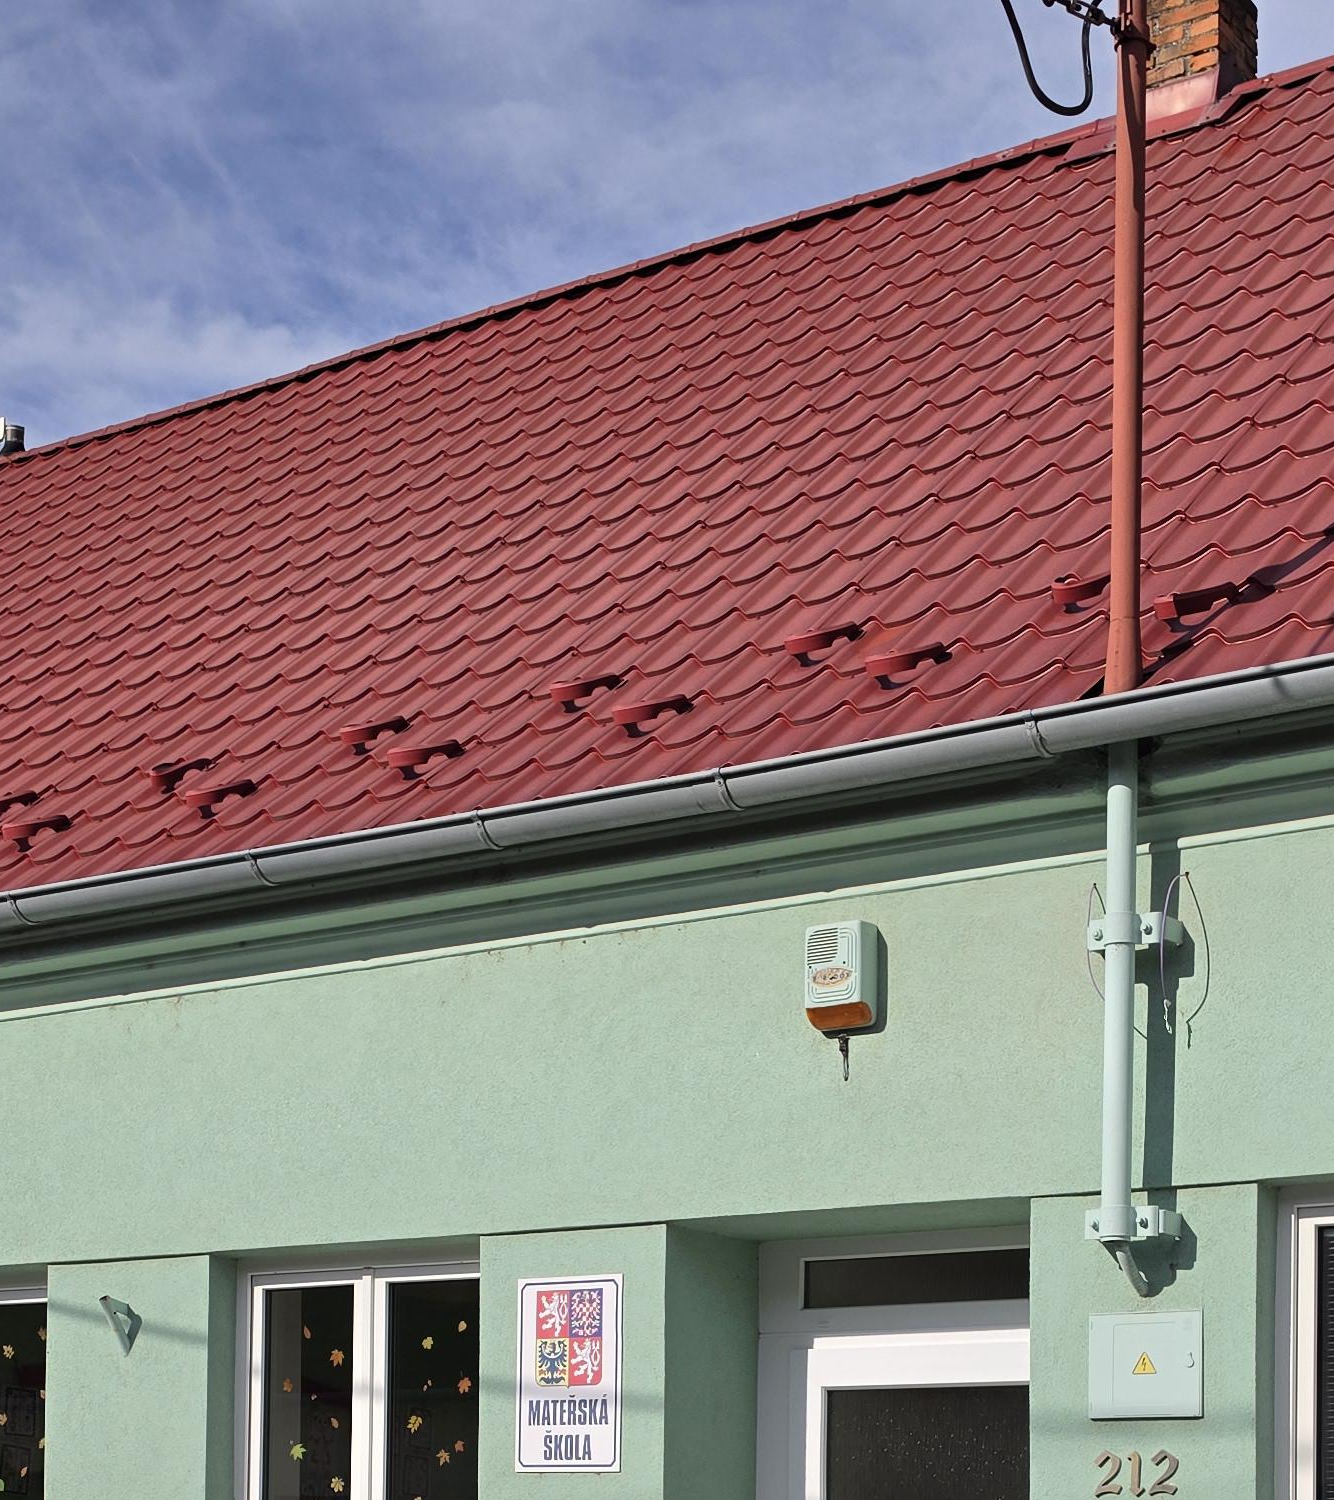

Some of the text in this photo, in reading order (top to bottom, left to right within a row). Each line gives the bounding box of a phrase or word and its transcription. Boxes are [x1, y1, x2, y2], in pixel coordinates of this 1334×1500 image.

[528, 1394, 609, 1427] MATEŘSKÁ
[543, 1430, 592, 1461] ŠKOLA
[1094, 1449, 1180, 1497] 212
